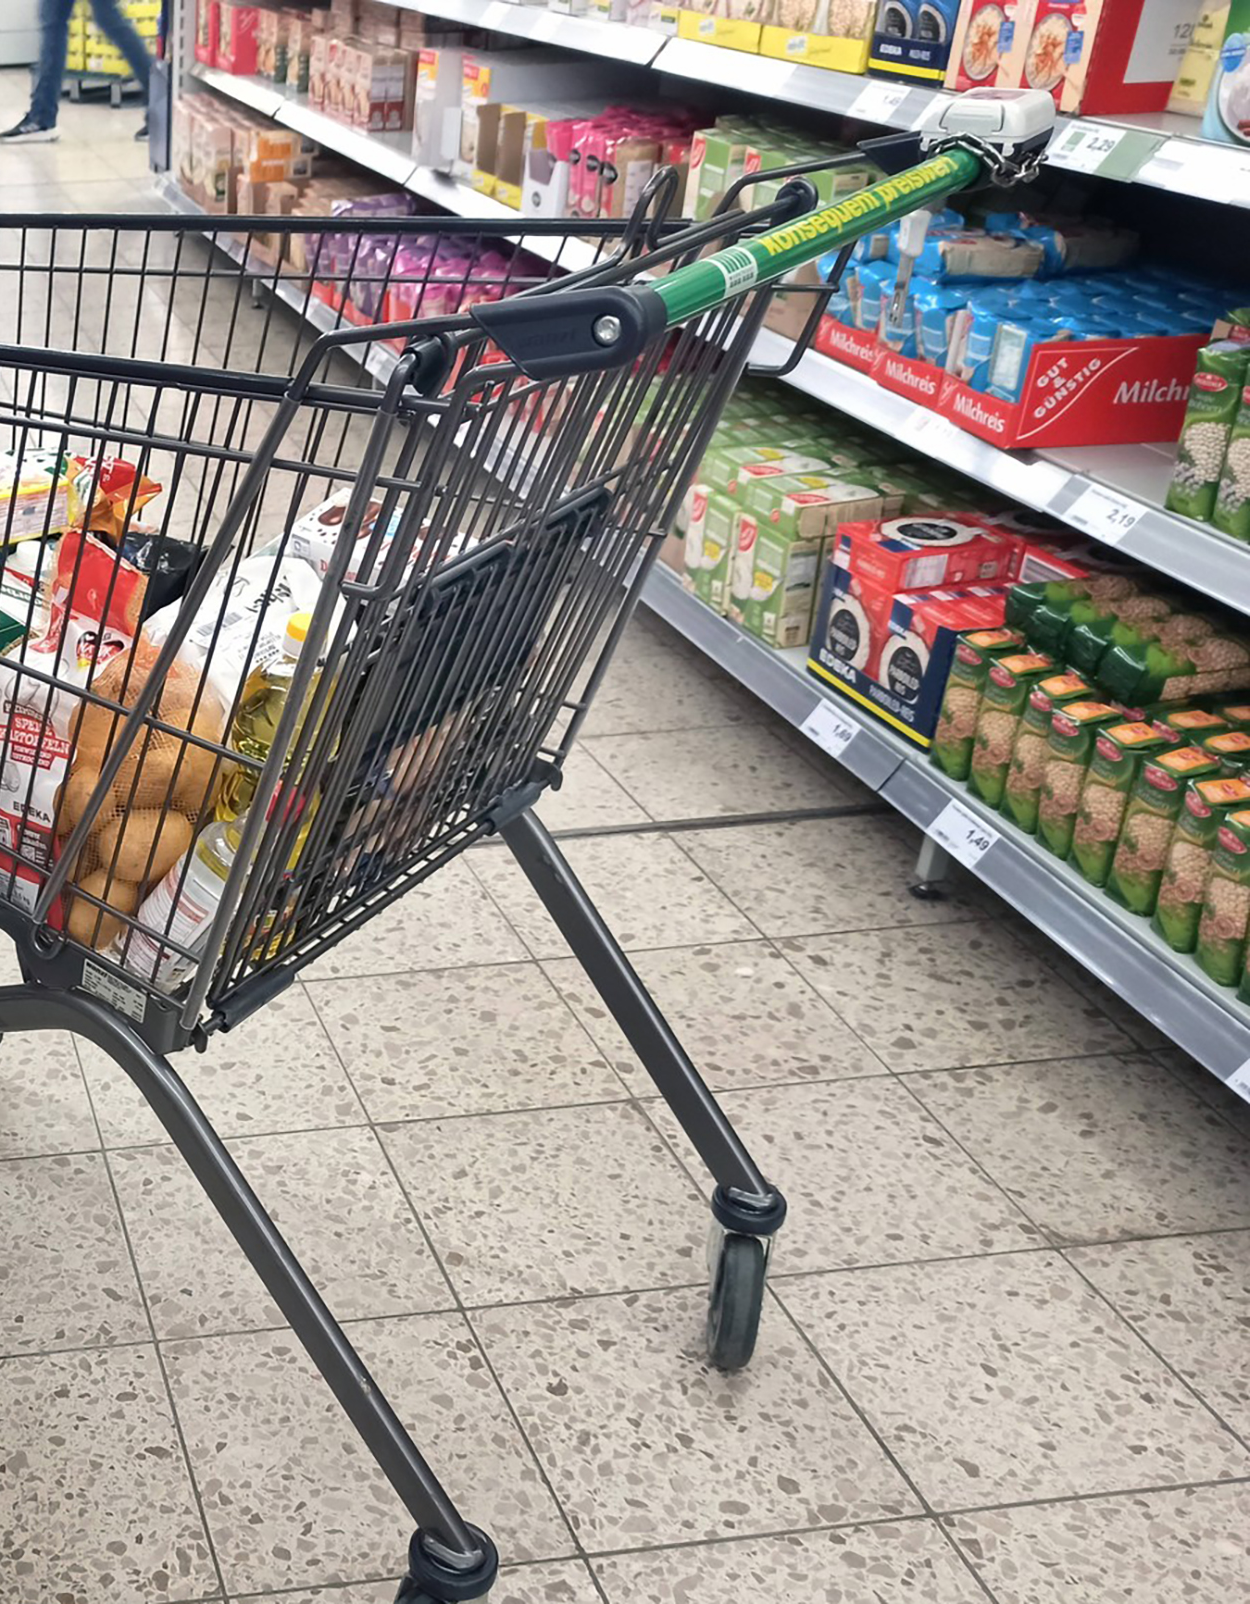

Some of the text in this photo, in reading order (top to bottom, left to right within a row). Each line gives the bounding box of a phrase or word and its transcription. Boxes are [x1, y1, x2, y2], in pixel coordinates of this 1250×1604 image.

[1086, 136, 1116, 152] 2,29
[758, 154, 960, 256] konsequent preiswert
[829, 328, 874, 363] Milchreis
[885, 359, 937, 396] Milchreis
[1033, 357, 1102, 419] GÜNSTIG
[1036, 356, 1069, 389] GUT
[1052, 375, 1068, 389] &
[953, 393, 1006, 433] Milchreis
[1106, 508, 1136, 528] 2,19
[819, 647, 857, 684] EDEKA
[966, 829, 990, 851] 1,49
